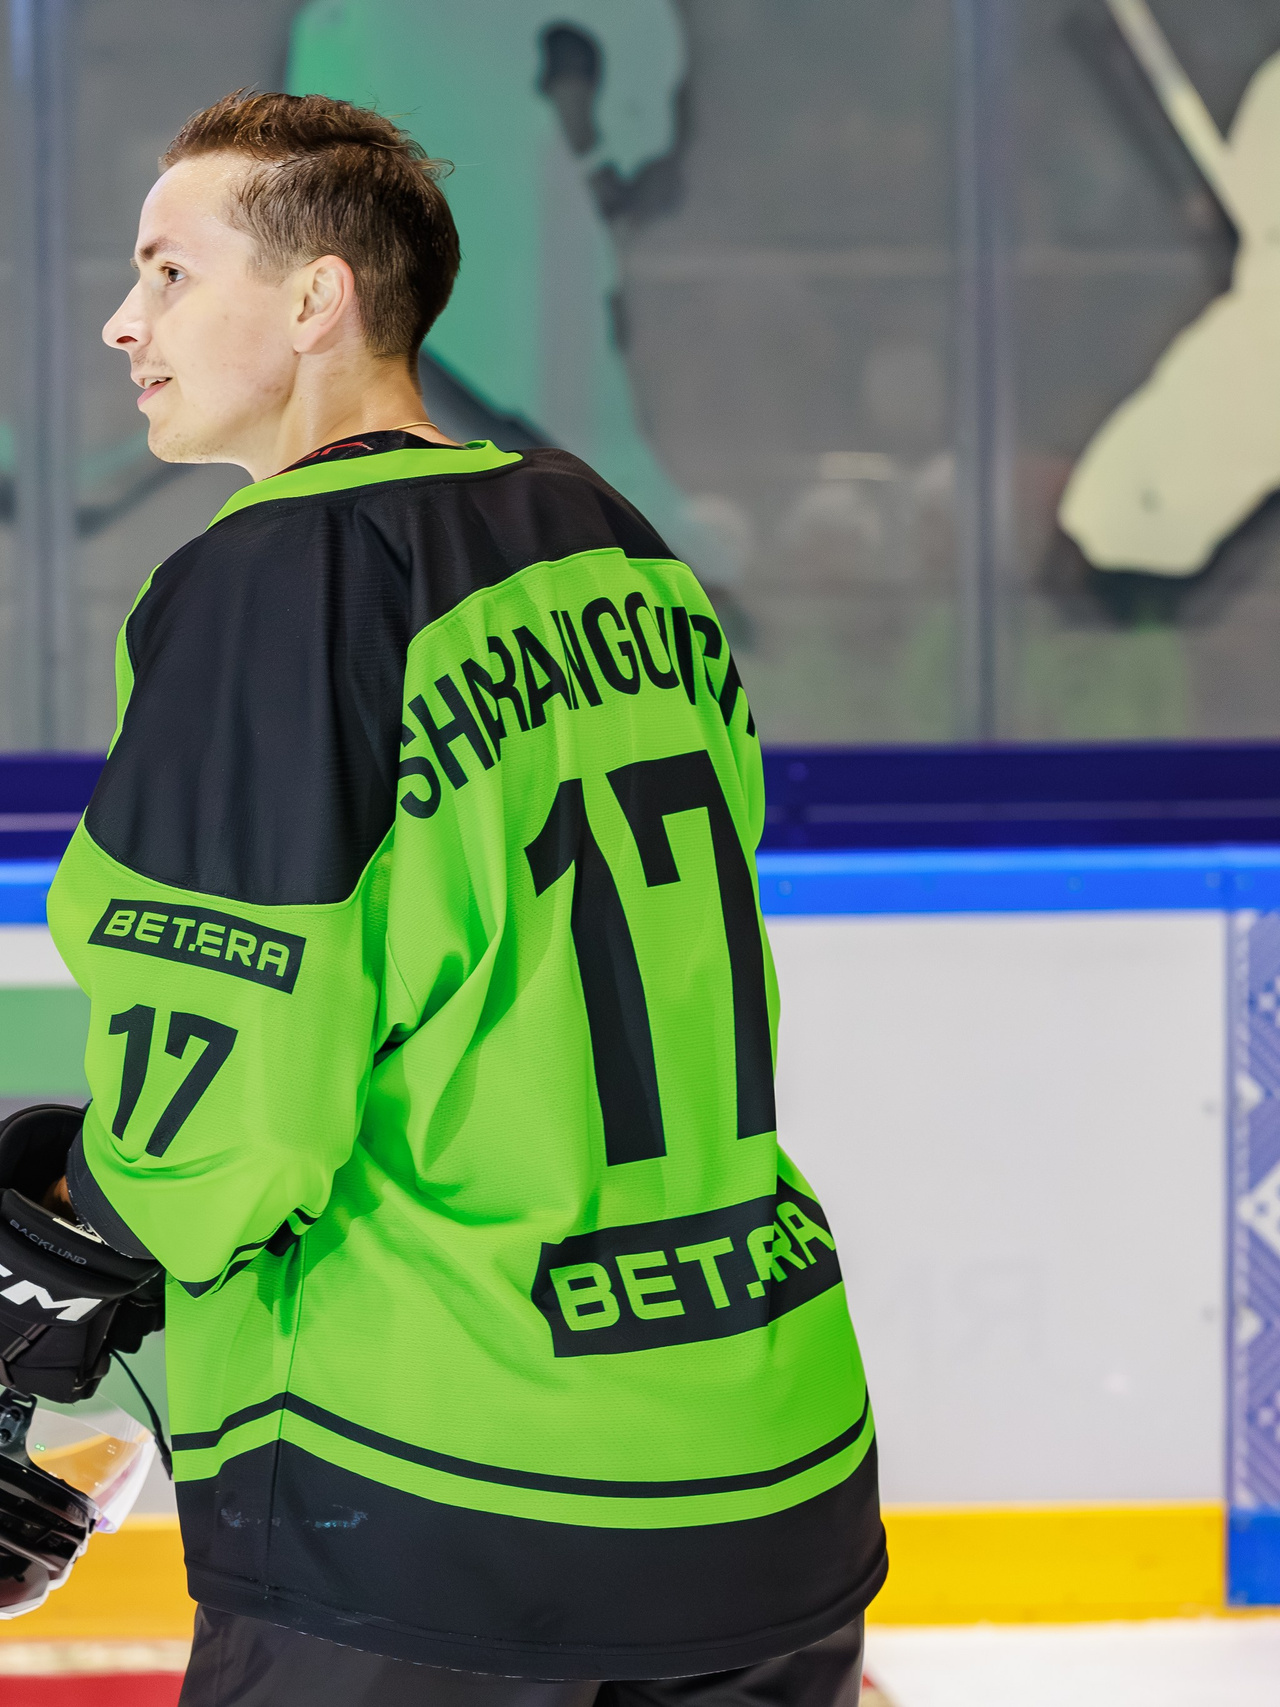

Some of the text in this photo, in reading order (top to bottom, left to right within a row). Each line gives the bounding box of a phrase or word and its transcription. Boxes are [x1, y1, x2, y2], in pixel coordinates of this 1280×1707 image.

[524, 749, 777, 1167] 17
[108, 1003, 239, 1158] 17
[9, 1218, 88, 1266] BACKLUND
